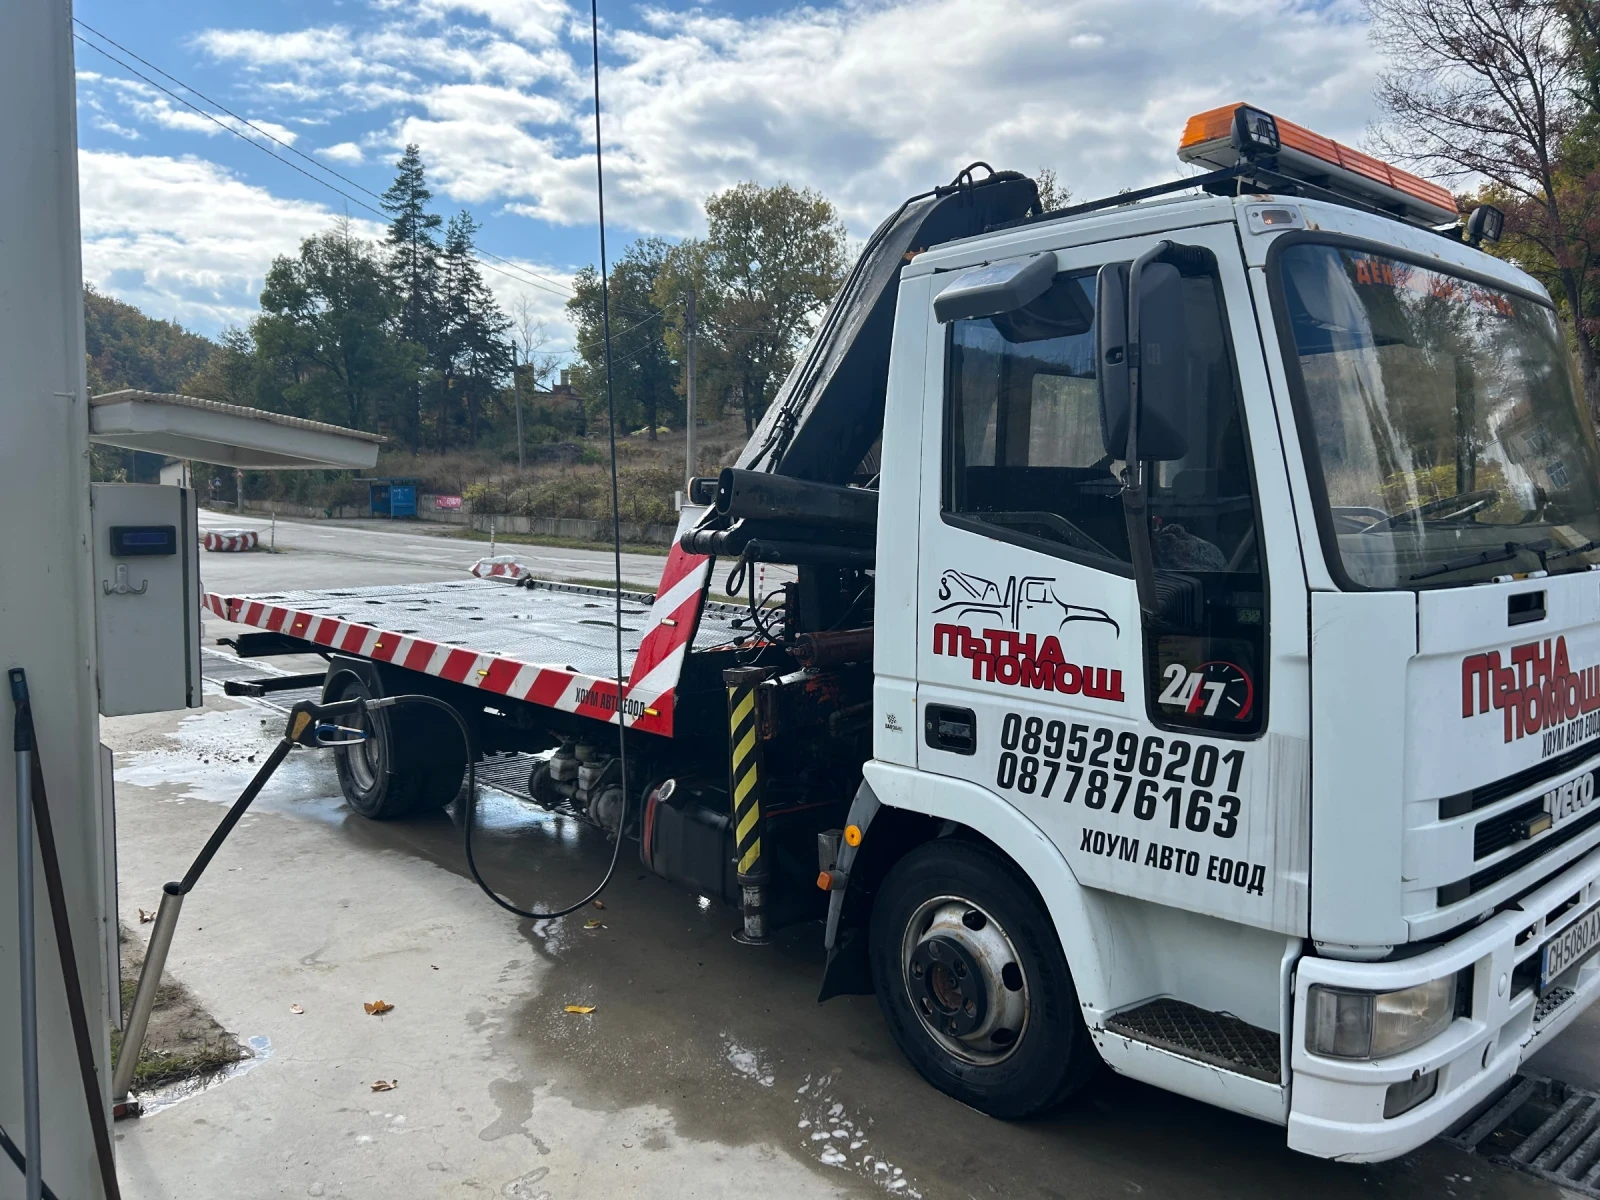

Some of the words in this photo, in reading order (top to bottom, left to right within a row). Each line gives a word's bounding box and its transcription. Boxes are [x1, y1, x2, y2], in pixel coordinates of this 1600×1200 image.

[933, 623, 1066, 667] ПЪТНА
[575, 687, 598, 709] ХОУМ
[623, 698, 645, 721] ЕООД
[972, 652, 1125, 702] ПОМОЩ
[1462, 635, 1571, 719] ПЪТНА
[1504, 665, 1600, 744] ПОМОЩ
[1000, 712, 1245, 793] 0895296201
[1542, 726, 1565, 759] ХОУМ
[1566, 717, 1584, 747] АВТО
[996, 751, 1241, 838] 0877876163
[1543, 772, 1594, 824] IVECO
[1080, 828, 1140, 859] ХОУМ
[1144, 841, 1199, 877] АВТО
[1206, 855, 1266, 896] ЕООД
